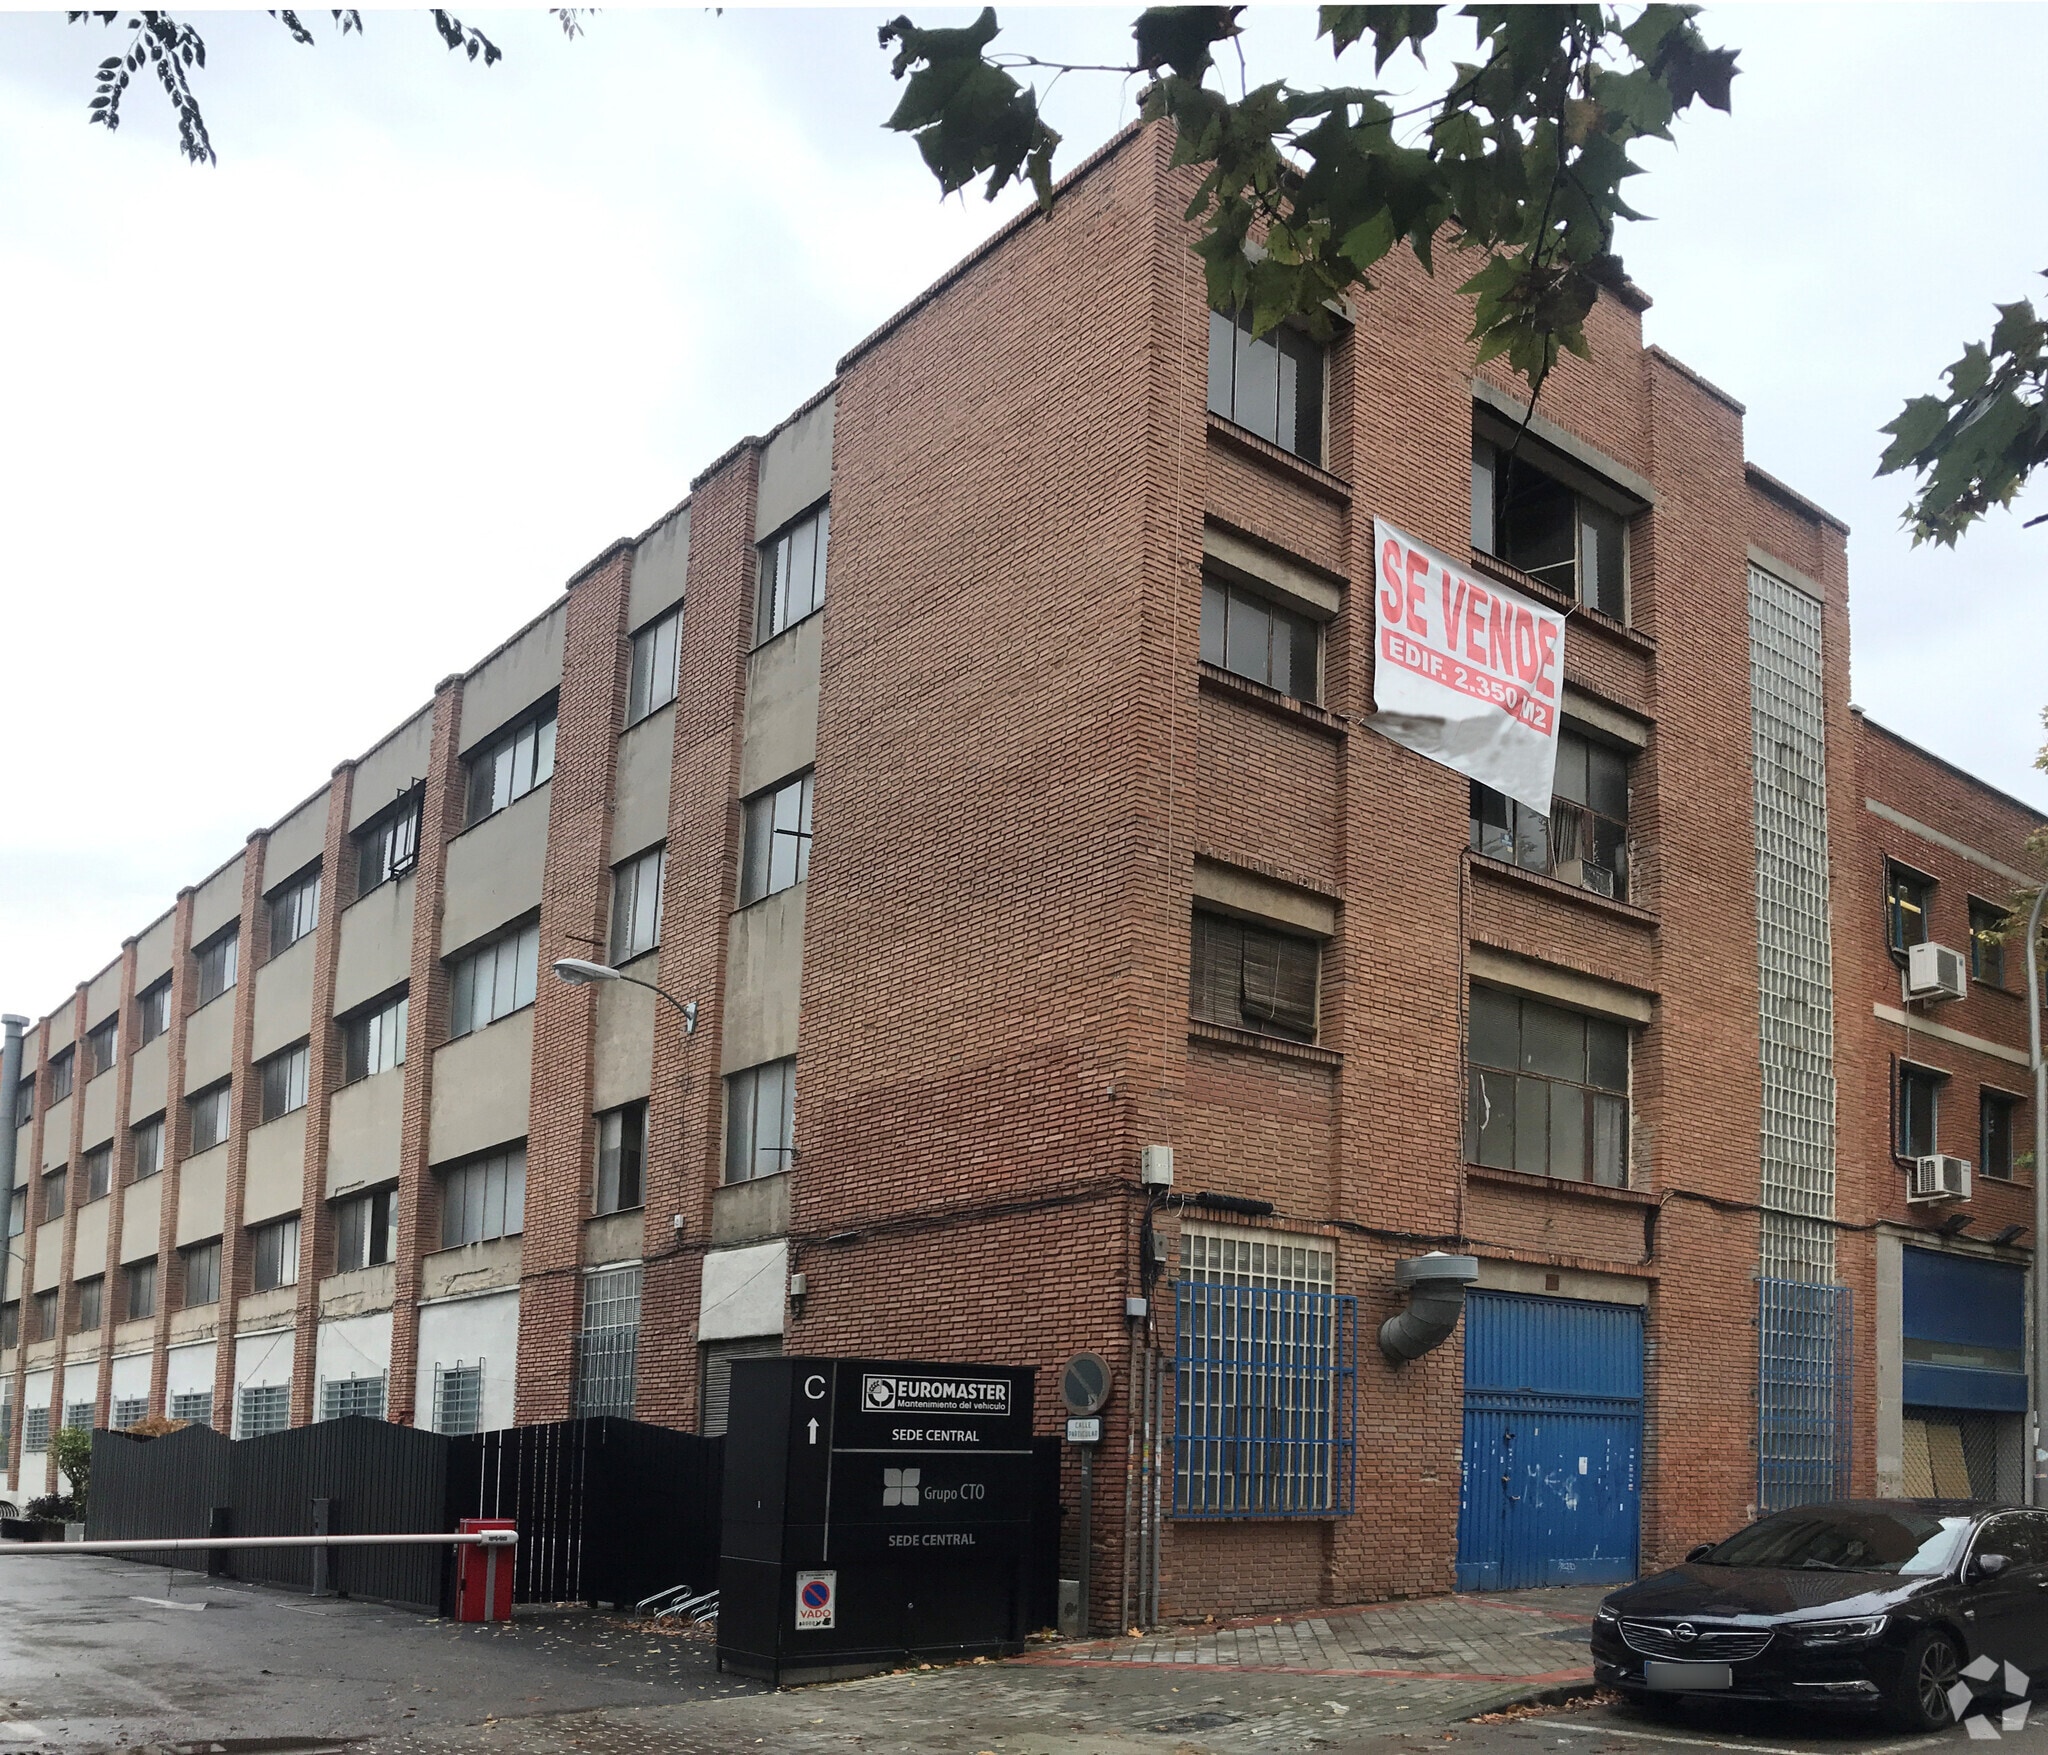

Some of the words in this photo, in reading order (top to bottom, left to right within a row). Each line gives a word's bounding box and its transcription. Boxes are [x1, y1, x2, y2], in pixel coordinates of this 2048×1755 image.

[1380, 539, 1429, 638] SE
[1441, 568, 1557, 699] VENDE
[1389, 638, 1448, 681] EDIF.
[1454, 667, 1518, 708] 2.350
[804, 1375, 826, 1399] C
[898, 1381, 1006, 1401] EUROMASTER
[897, 1400, 957, 1410] Mantenimiento
[959, 1401, 972, 1409] del
[892, 1429, 923, 1441] SEDE
[926, 1430, 980, 1442] CENTRAL
[924, 1486, 958, 1503] Grupo
[960, 1483, 985, 1500] CTO
[888, 1535, 920, 1547] SEDE
[921, 1533, 976, 1546] CENTRAL
[800, 1609, 831, 1618] VADO
